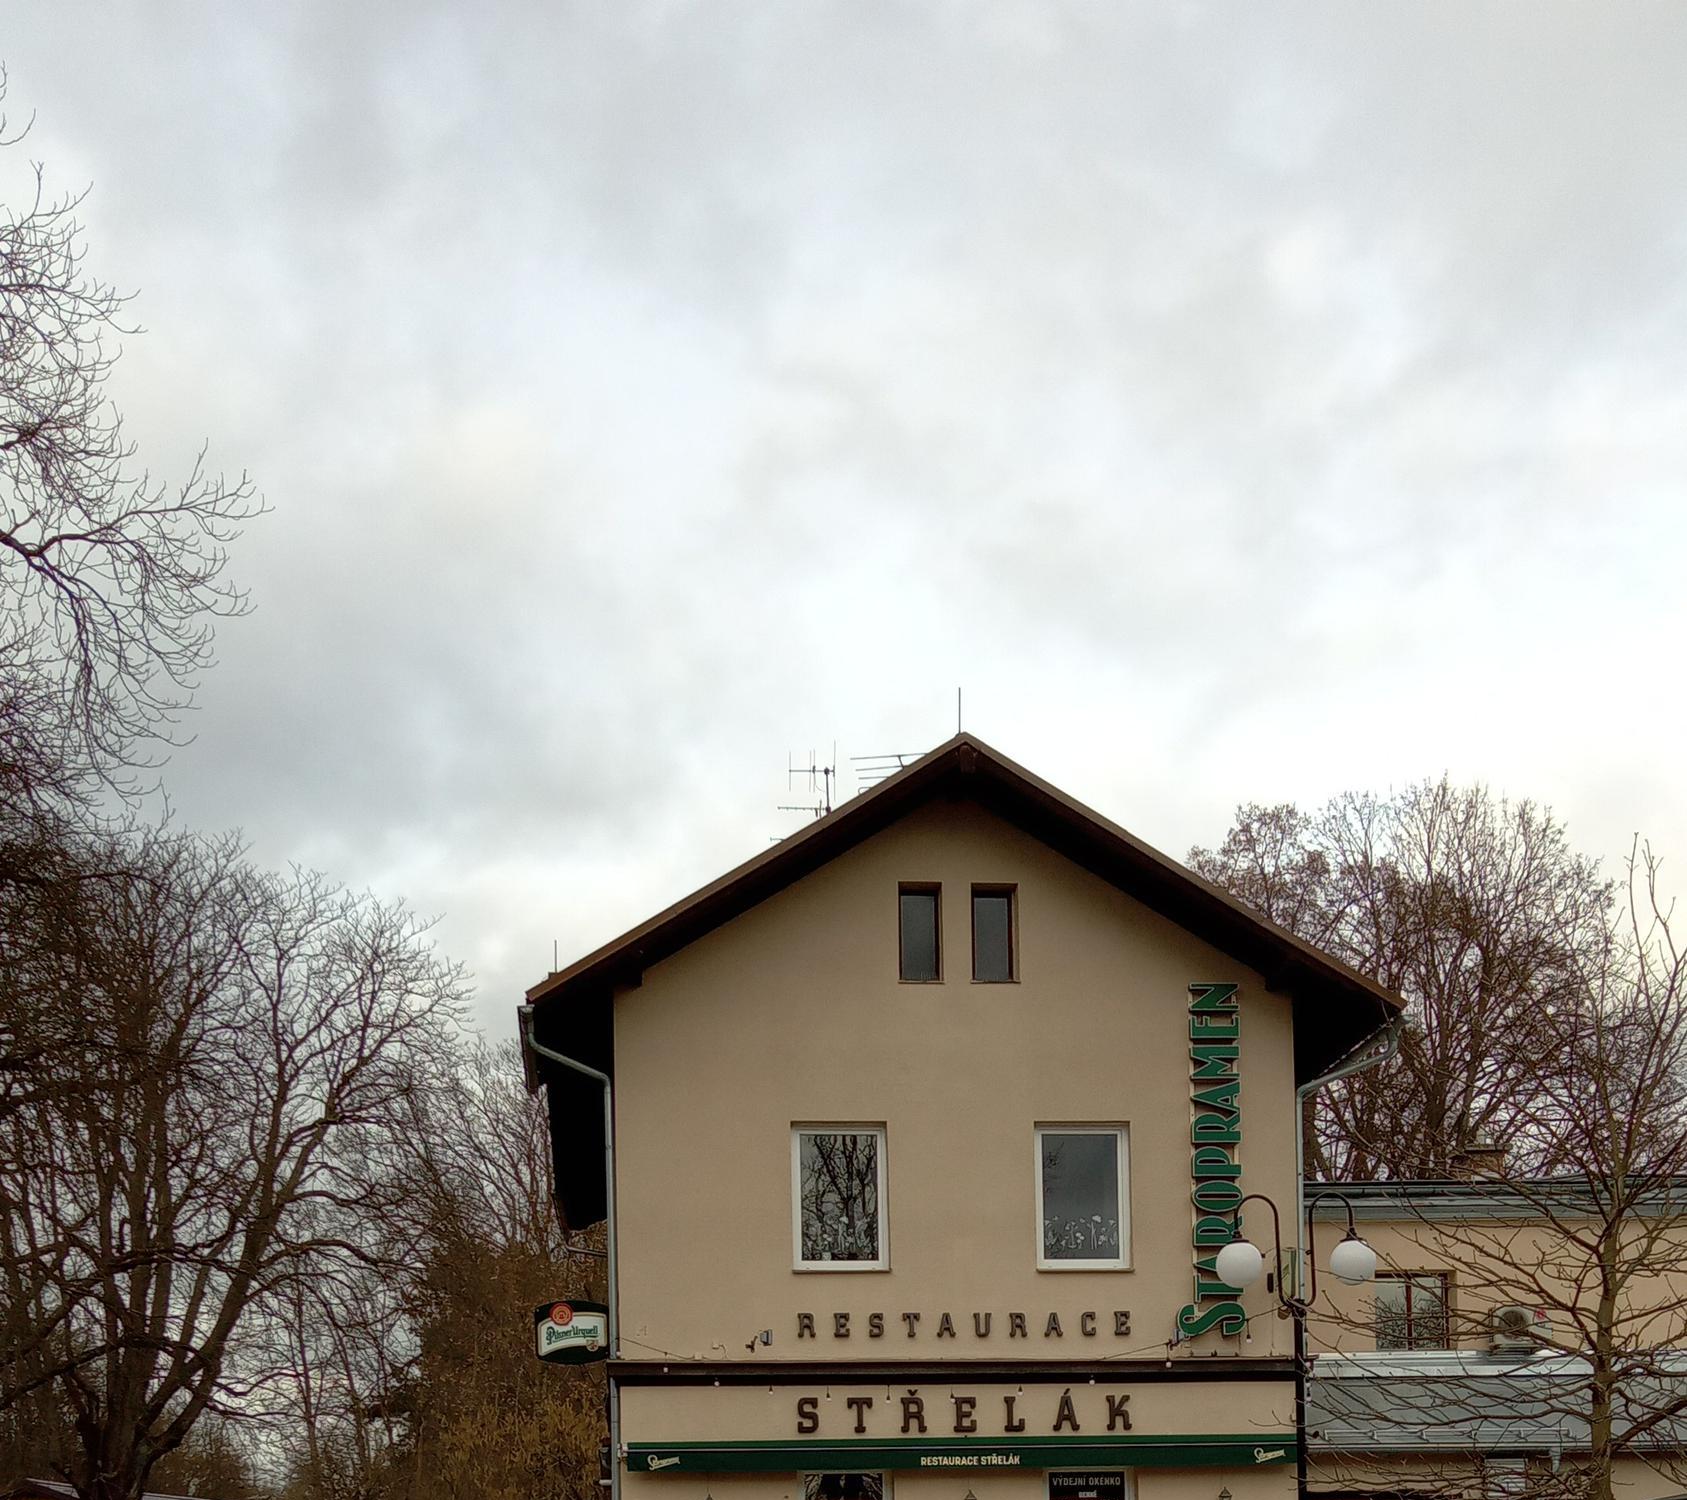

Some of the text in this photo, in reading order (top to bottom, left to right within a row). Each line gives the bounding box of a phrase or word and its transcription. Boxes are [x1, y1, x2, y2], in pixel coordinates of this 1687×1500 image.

[546, 1325, 598, 1345] Pilsner Urquell
[797, 1311, 1132, 1339] RESTAURACE
[797, 1388, 1133, 1434] STŘELÁK
[920, 1453, 1020, 1466] RESTAURACE STŘELÁK
